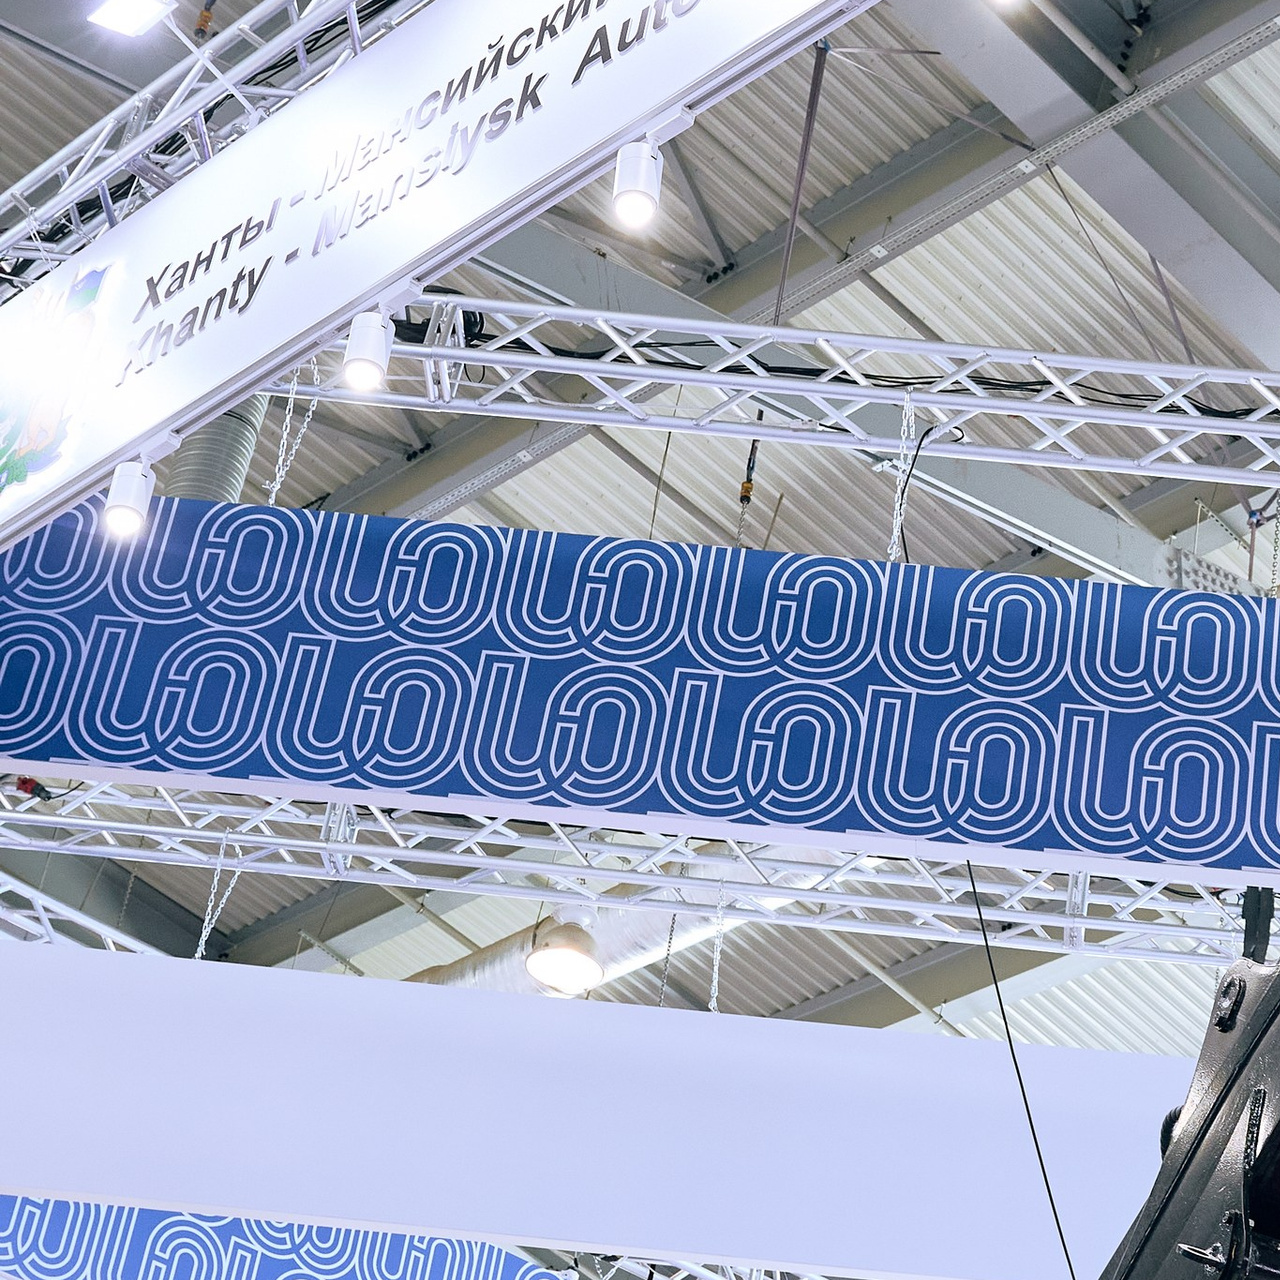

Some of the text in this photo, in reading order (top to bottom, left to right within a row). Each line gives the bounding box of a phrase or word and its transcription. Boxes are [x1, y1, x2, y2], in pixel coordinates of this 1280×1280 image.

[115, 255, 275, 388] Khanty
[311, 72, 550, 257] Mansiysk
[132, 196, 283, 324] Ханты
